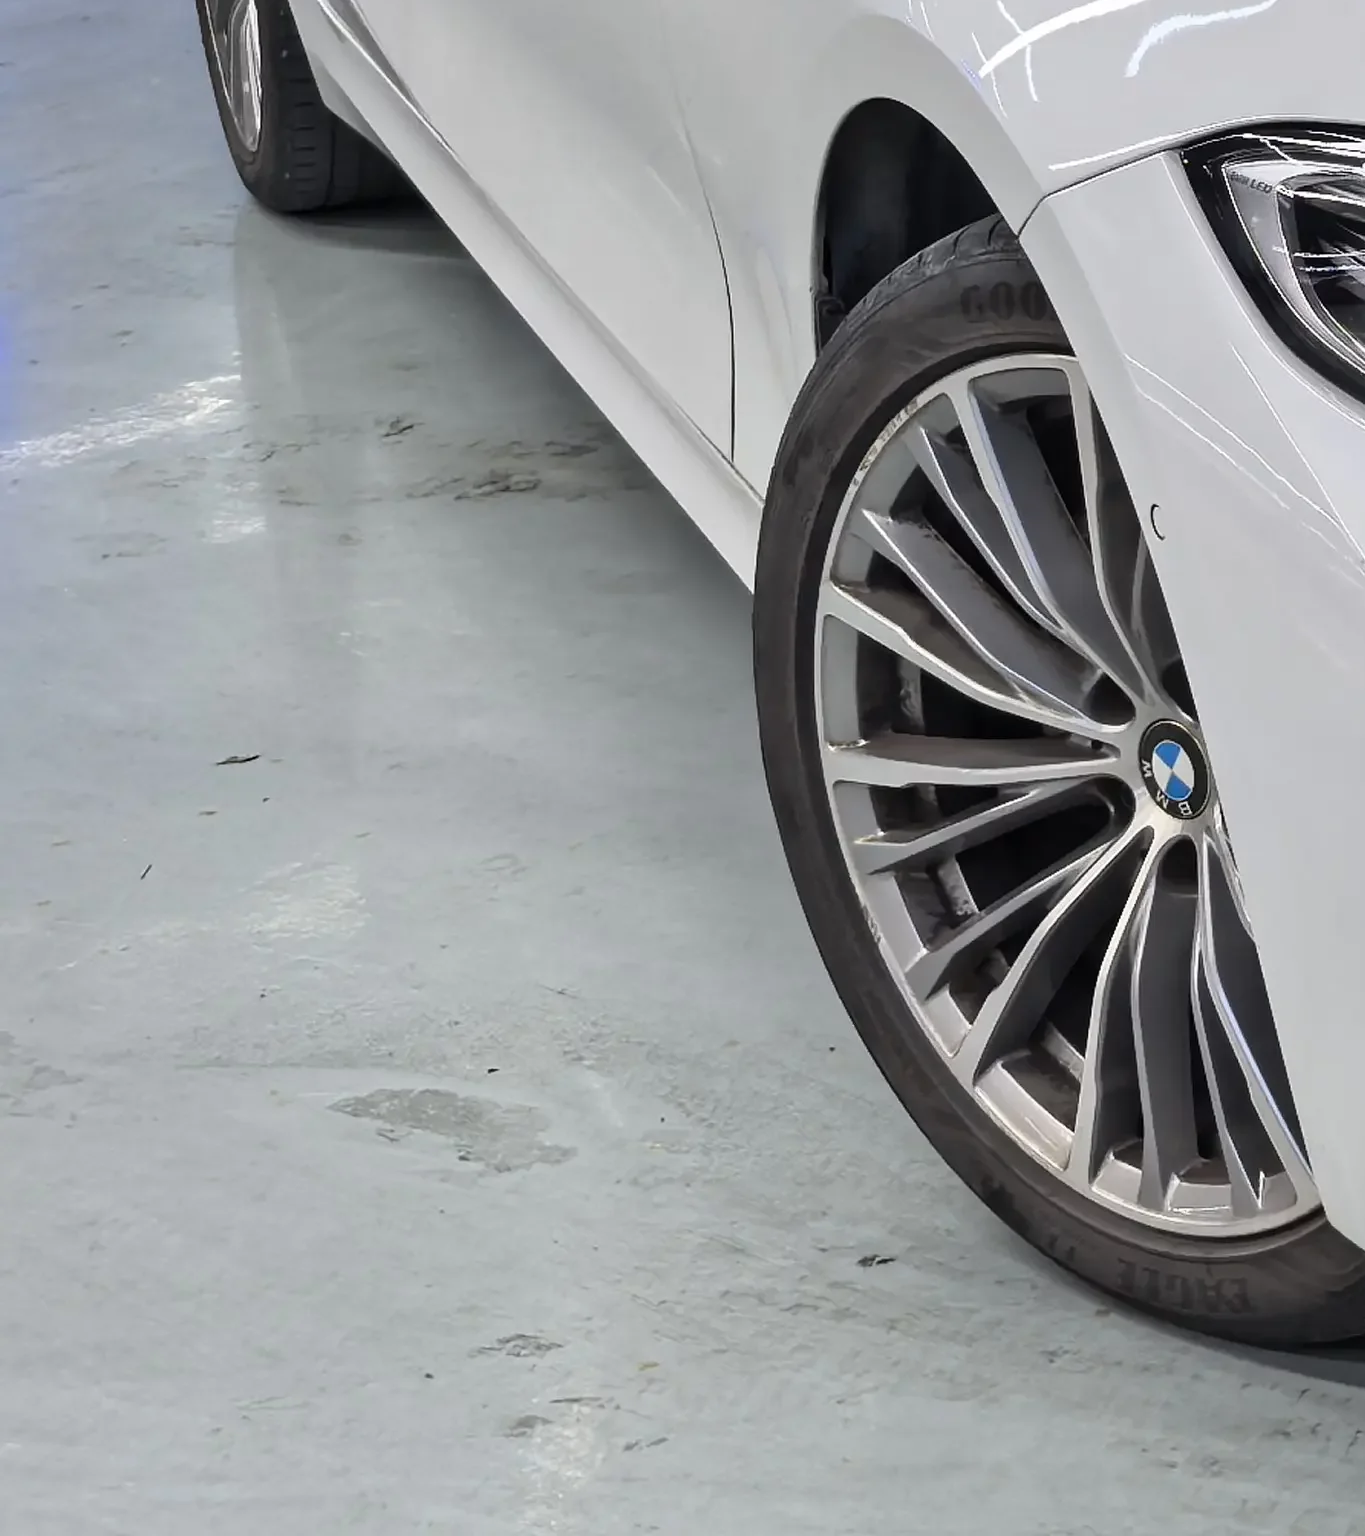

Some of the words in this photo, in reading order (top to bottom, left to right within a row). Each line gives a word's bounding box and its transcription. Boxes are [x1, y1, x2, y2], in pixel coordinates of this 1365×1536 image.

[1250, 178, 1273, 194] LED
[960, 281, 1055, 324] GOO
[1140, 759, 1193, 816] BMW
